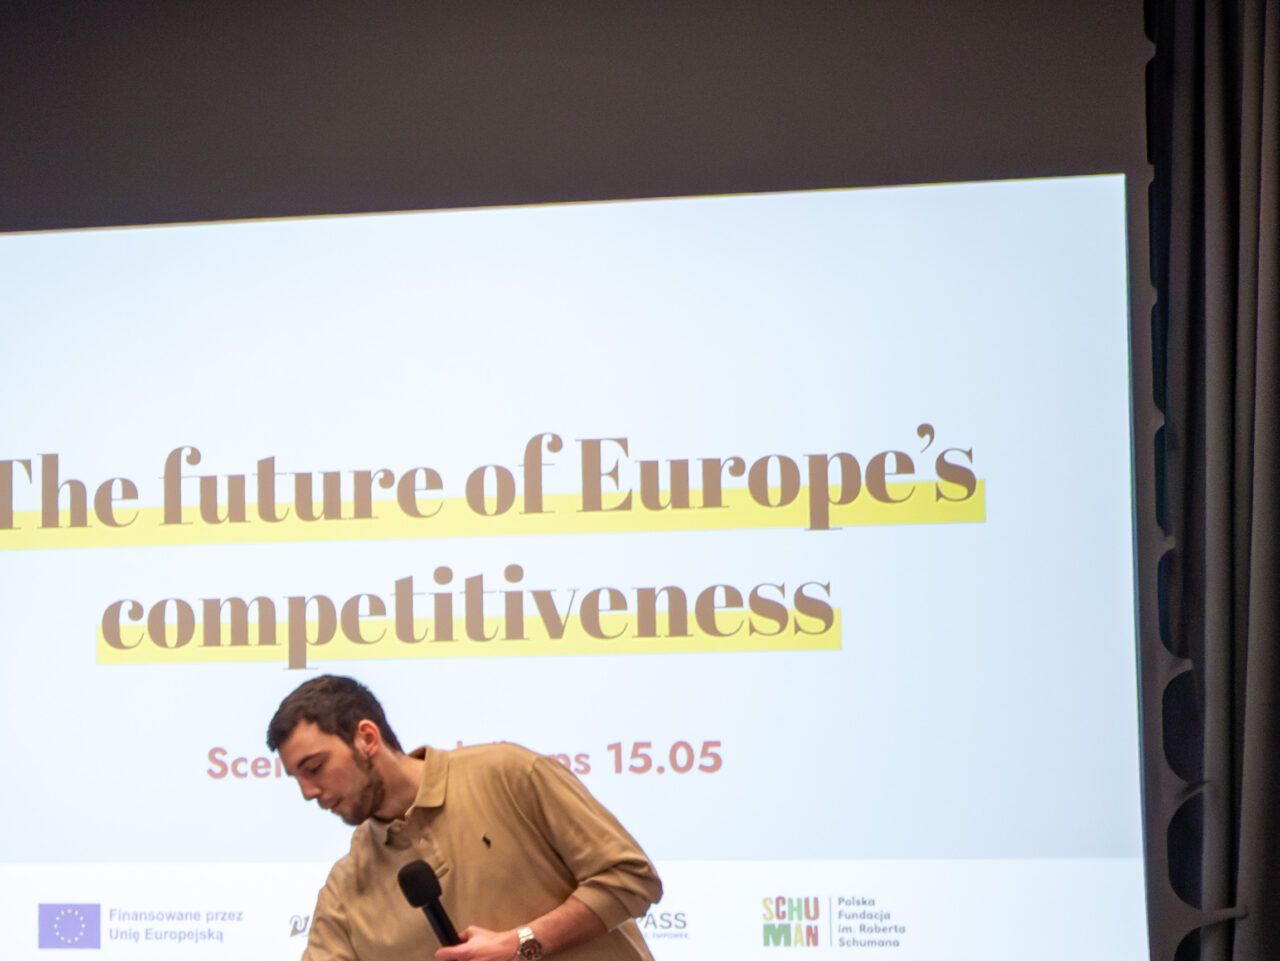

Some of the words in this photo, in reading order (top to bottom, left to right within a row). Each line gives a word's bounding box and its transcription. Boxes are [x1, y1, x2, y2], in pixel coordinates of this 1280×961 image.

[158, 445, 444, 527] future
[464, 431, 564, 517] of
[100, 564, 836, 671] competitiveness
[606, 741, 723, 775] 15.05
[108, 907, 202, 922] Finansowane
[205, 910, 244, 924] przez
[762, 896, 820, 921] SCHU
[837, 896, 876, 907] Polska
[837, 910, 892, 923] Fundacja
[639, 912, 688, 930] ASS
[108, 926, 141, 943] Unię
[144, 926, 225, 945] Europejską
[763, 922, 819, 948] MAN
[858, 923, 907, 936] Roberta
[838, 936, 901, 948] Schumana
